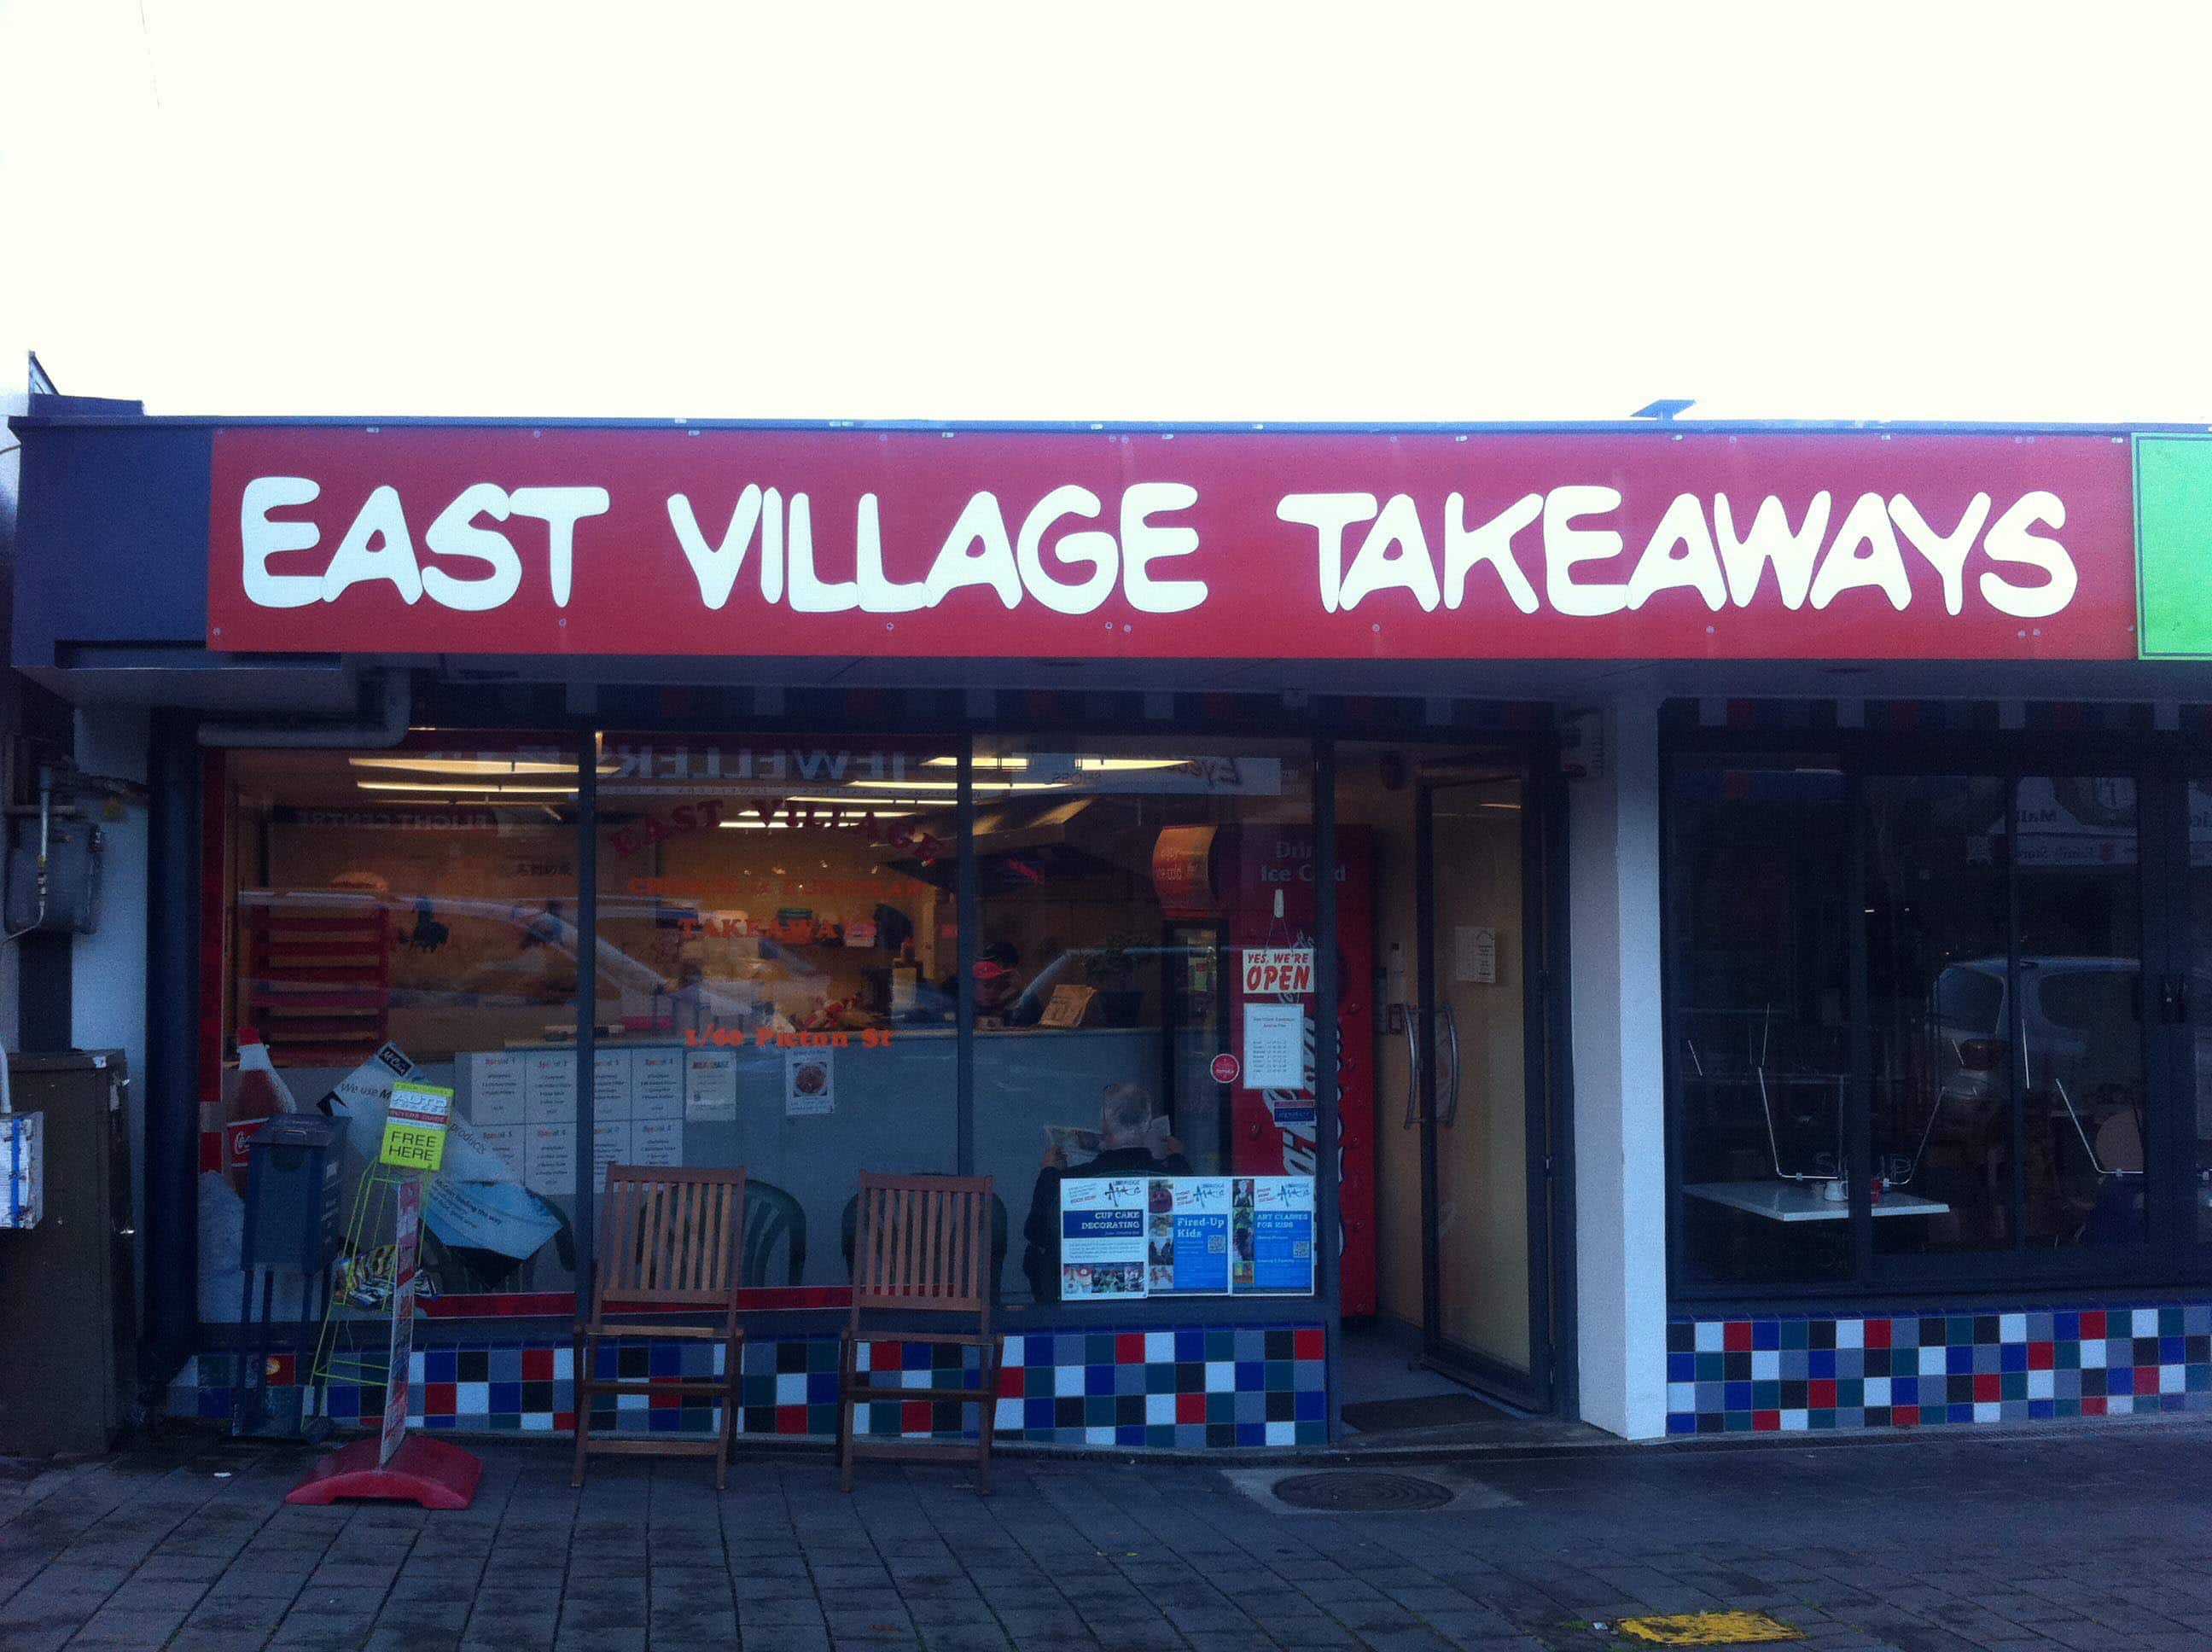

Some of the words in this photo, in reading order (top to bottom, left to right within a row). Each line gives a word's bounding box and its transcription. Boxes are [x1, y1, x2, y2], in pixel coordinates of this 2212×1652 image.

[241, 475, 610, 611] EAST
[666, 481, 1208, 615] VILLAGE
[1275, 484, 2079, 619] TAKEAWAYS
[1298, 864, 1347, 882] Cd
[1272, 952, 1309, 964] WE'RE
[1245, 965, 1311, 991] OPEN
[684, 1022, 744, 1048] 1/60
[755, 1027, 850, 1049] Picton
[862, 1028, 894, 1049] St
[390, 1131, 437, 1149] FREE
[388, 1144, 433, 1161] HERE
[1094, 1211, 1113, 1219] CUP
[1177, 1218, 1225, 1229] Fired-Up
[1080, 1221, 1140, 1230] DECORATING
[1177, 1229, 1202, 1237] Kids
